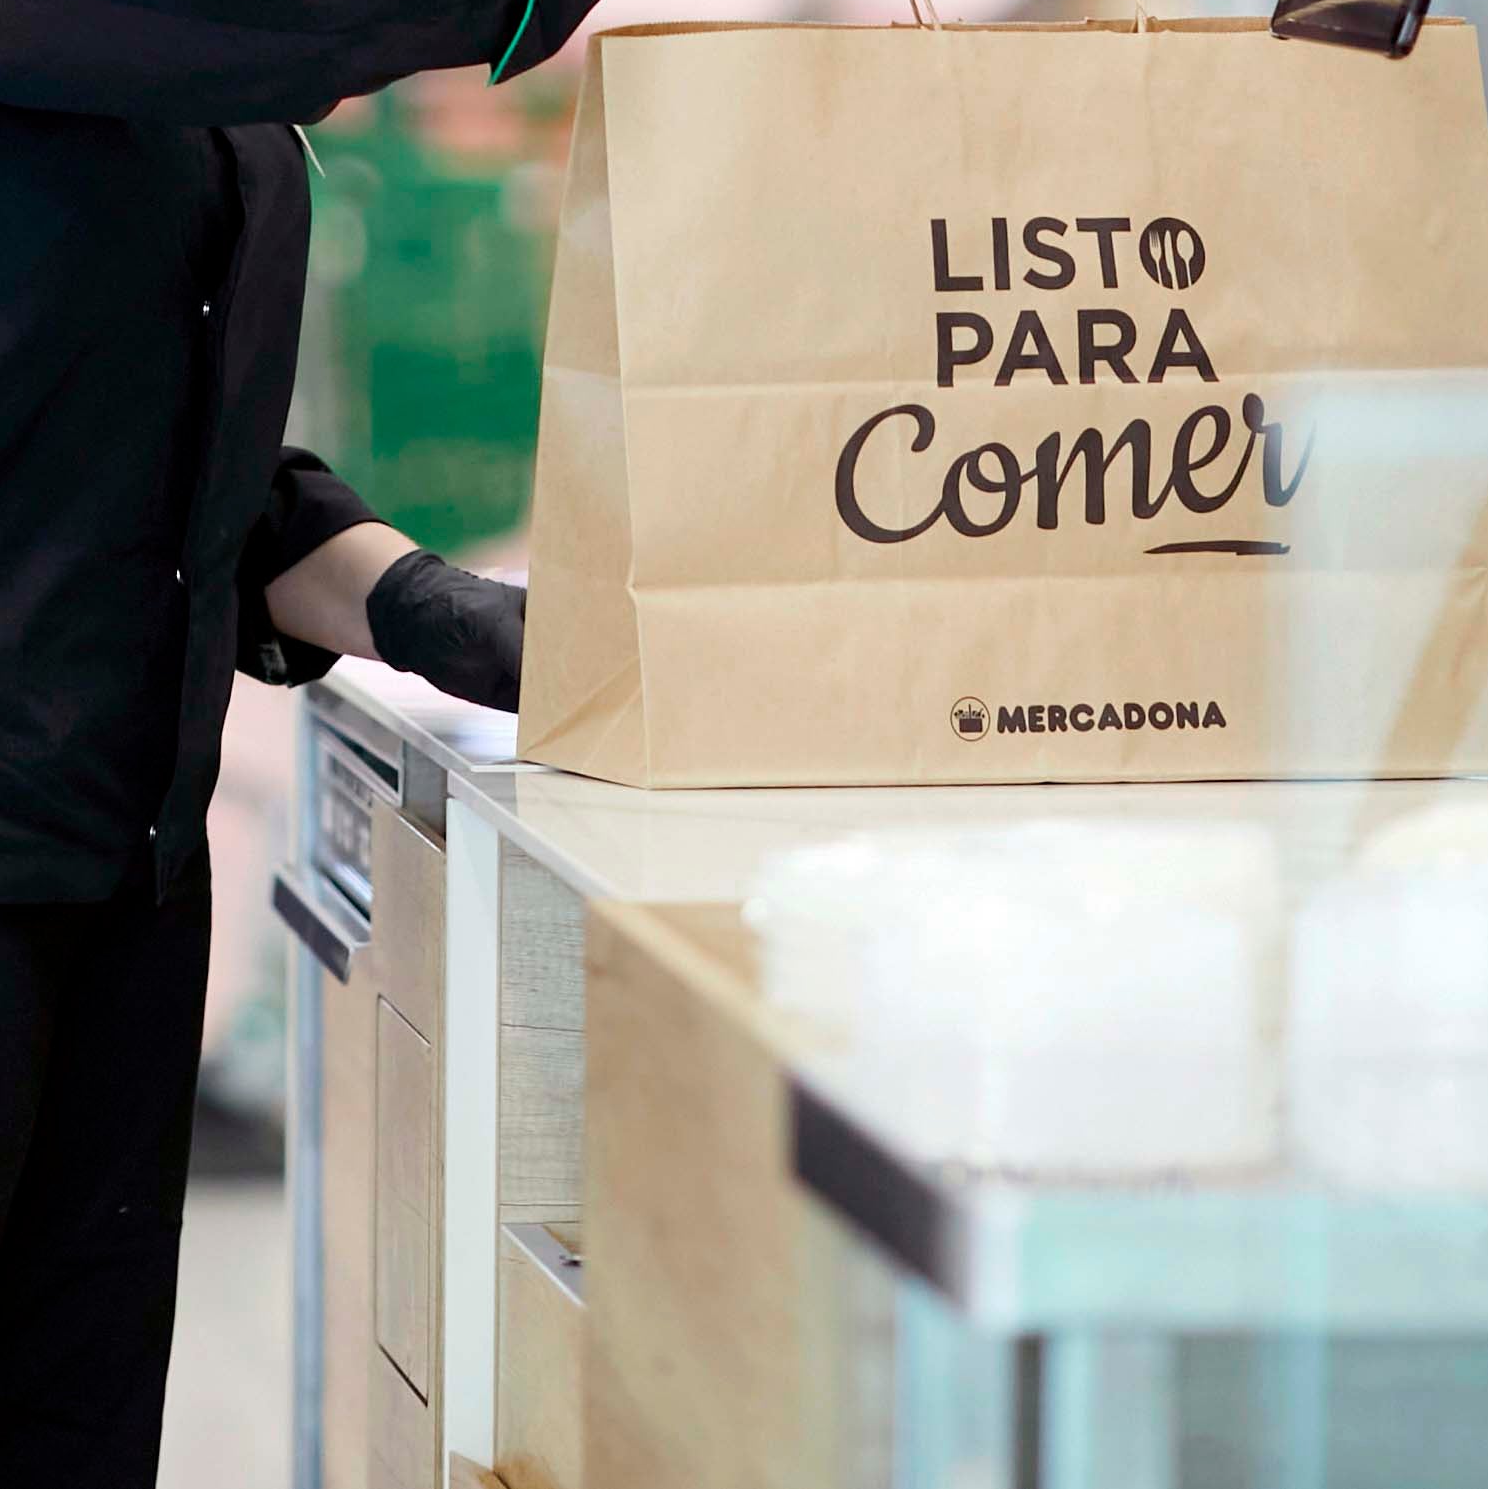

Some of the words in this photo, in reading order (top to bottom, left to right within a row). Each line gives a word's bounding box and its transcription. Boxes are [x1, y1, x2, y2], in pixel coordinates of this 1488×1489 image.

[930, 215, 1206, 292] LISTO
[935, 307, 1219, 387] PARA
[834, 392, 1317, 544] Comer
[996, 700, 1227, 734] MERCADONA
